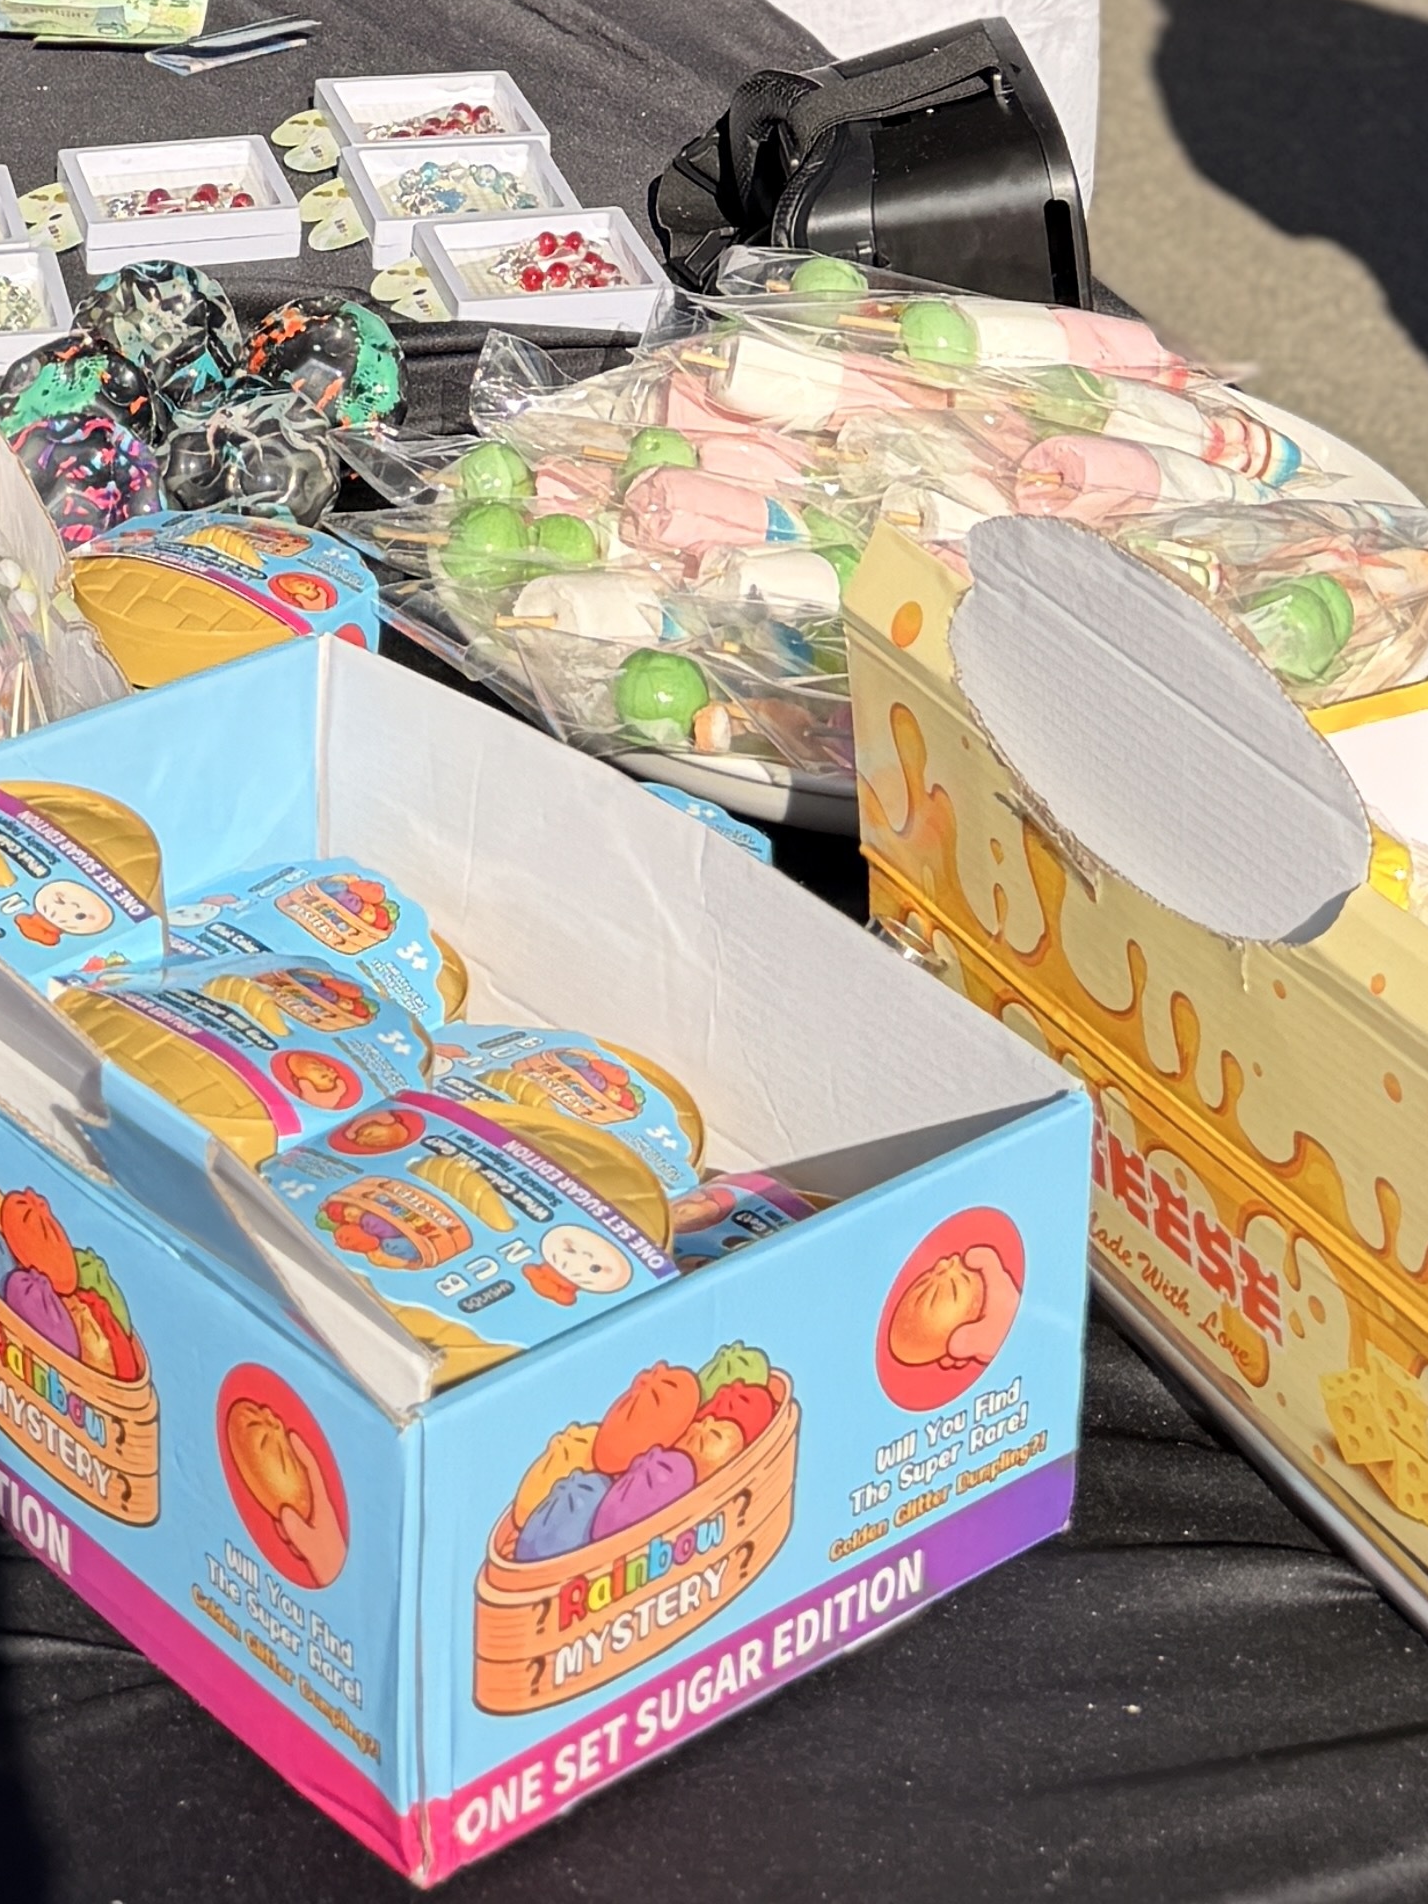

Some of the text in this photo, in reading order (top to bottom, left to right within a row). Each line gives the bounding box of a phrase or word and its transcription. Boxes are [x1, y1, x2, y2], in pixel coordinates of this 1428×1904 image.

[15, 808, 147, 917] ONE SET SUGAR EDITION
[502, 1139, 666, 1270] ONE SET SUGAR EDITION
[1092, 1113, 1283, 1348] EESE
[1090, 1212, 1250, 1368] ade With Love
[849, 1401, 1029, 1516] The Super Rare!
[875, 1375, 1023, 1475] Will You Find
[557, 1511, 727, 1633] Rainbow
[828, 1518, 889, 1562] Golden
[893, 1484, 953, 1528] Glitter
[205, 1551, 363, 1711] The Super Rare!
[224, 1539, 354, 1671] Will You Find
[551, 1558, 731, 1689] MYSTERY
[455, 1547, 926, 1847] ONE SET SUGAR EDITION
